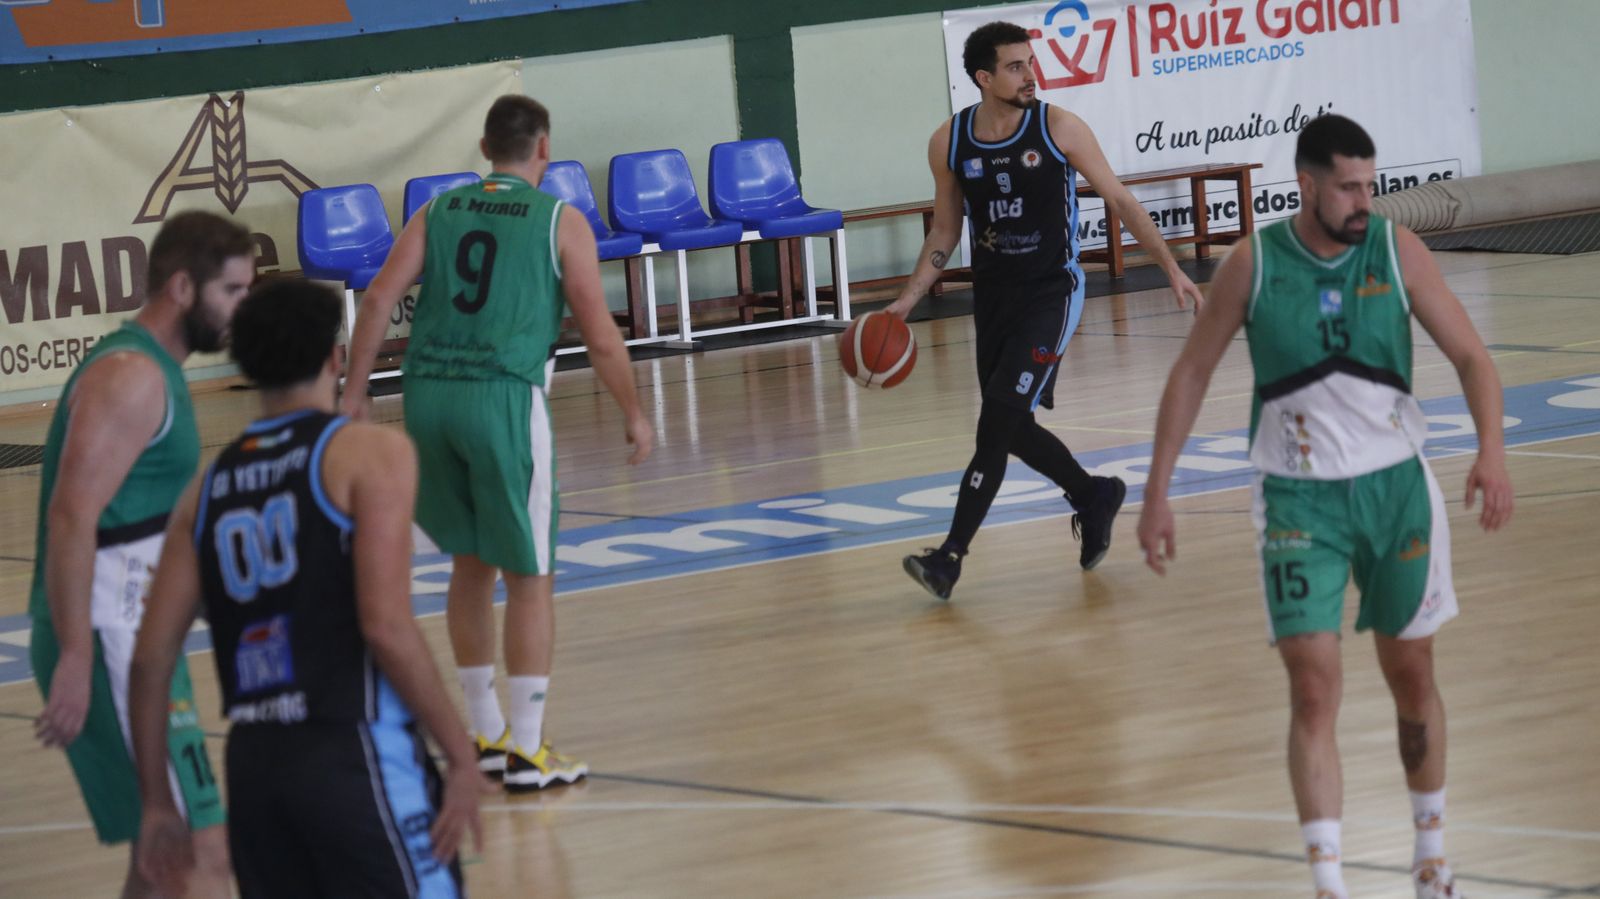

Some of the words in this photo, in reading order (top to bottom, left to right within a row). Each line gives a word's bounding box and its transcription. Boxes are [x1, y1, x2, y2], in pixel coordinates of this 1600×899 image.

[1152, 41, 1305, 76] SUPERMERCADOS
[1136, 120, 1165, 153] A
[1171, 129, 1202, 149] un
[1204, 112, 1279, 154] pasito
[1284, 103, 1310, 133] de
[996, 172, 1012, 194] 9
[452, 230, 498, 316] 9
[0, 335, 104, 375] OS-CERE
[1316, 317, 1350, 353] 15
[1015, 371, 1035, 395] 9
[214, 490, 299, 604] 00
[1270, 560, 1310, 605] 15
